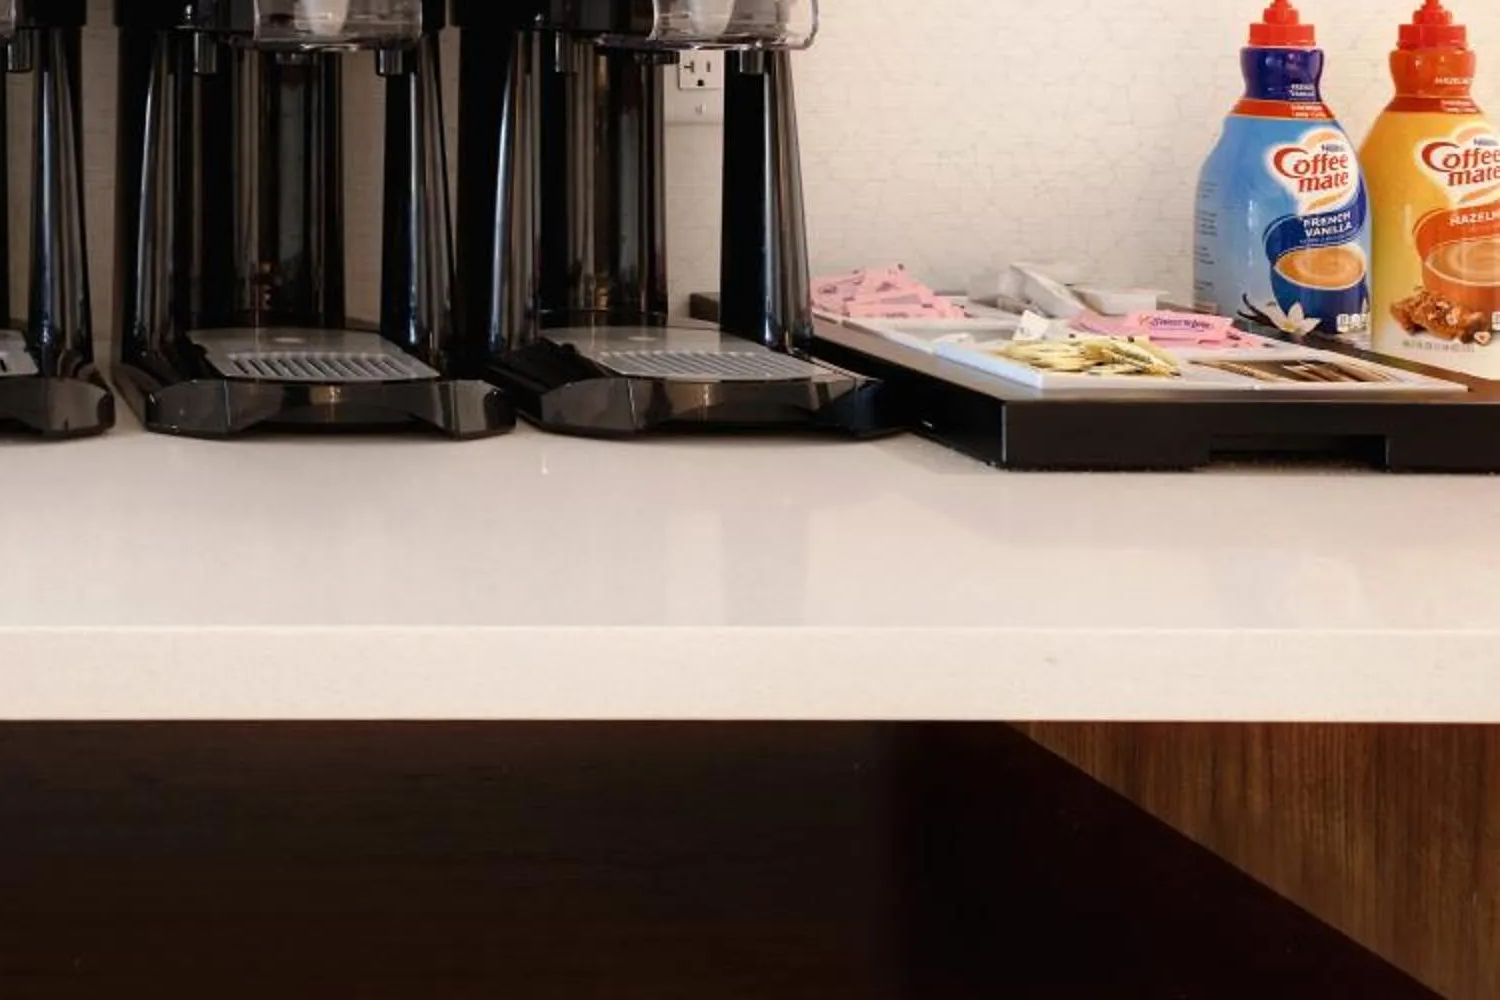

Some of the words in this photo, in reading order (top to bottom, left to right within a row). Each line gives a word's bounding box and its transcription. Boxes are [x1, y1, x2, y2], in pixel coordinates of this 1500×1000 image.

[1273, 146, 1349, 179] Coffee
[1298, 170, 1349, 193] mate
[1303, 210, 1352, 228] FRENCH
[1304, 221, 1353, 237] VANILLA
